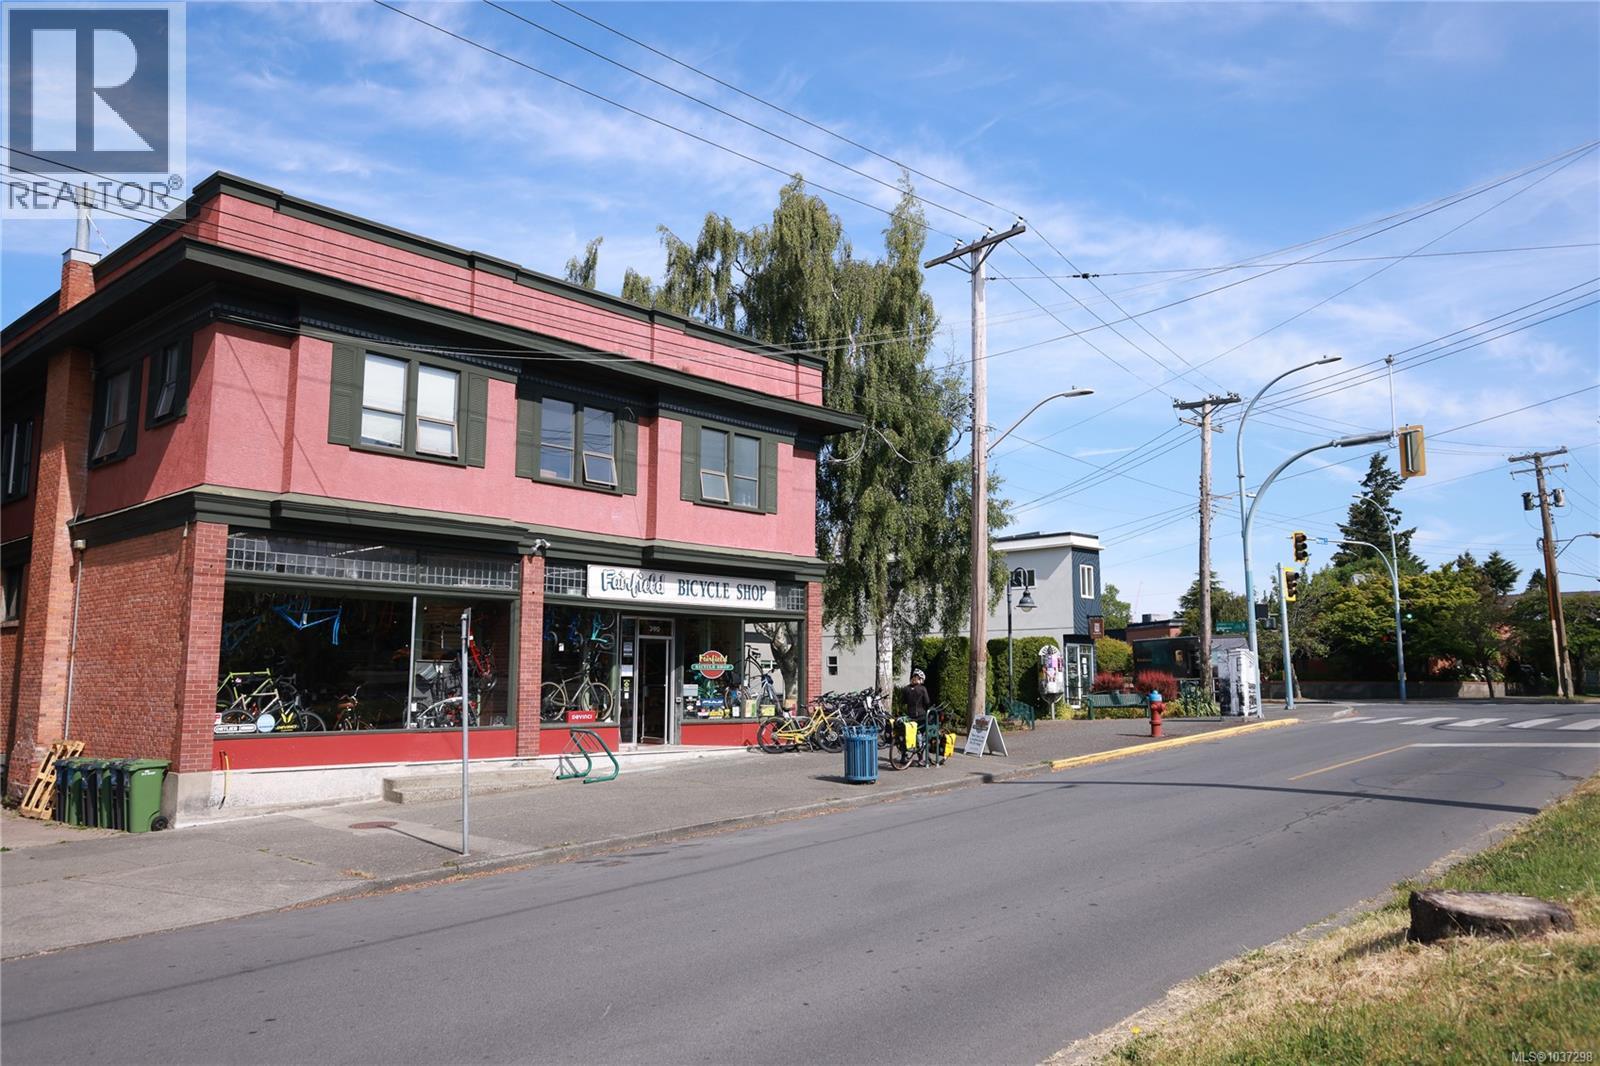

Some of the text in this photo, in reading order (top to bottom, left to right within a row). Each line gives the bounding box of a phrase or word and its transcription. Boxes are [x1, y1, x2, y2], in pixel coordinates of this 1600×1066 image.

[600, 569, 767, 601] Fairfield BICYCLE SHOP
